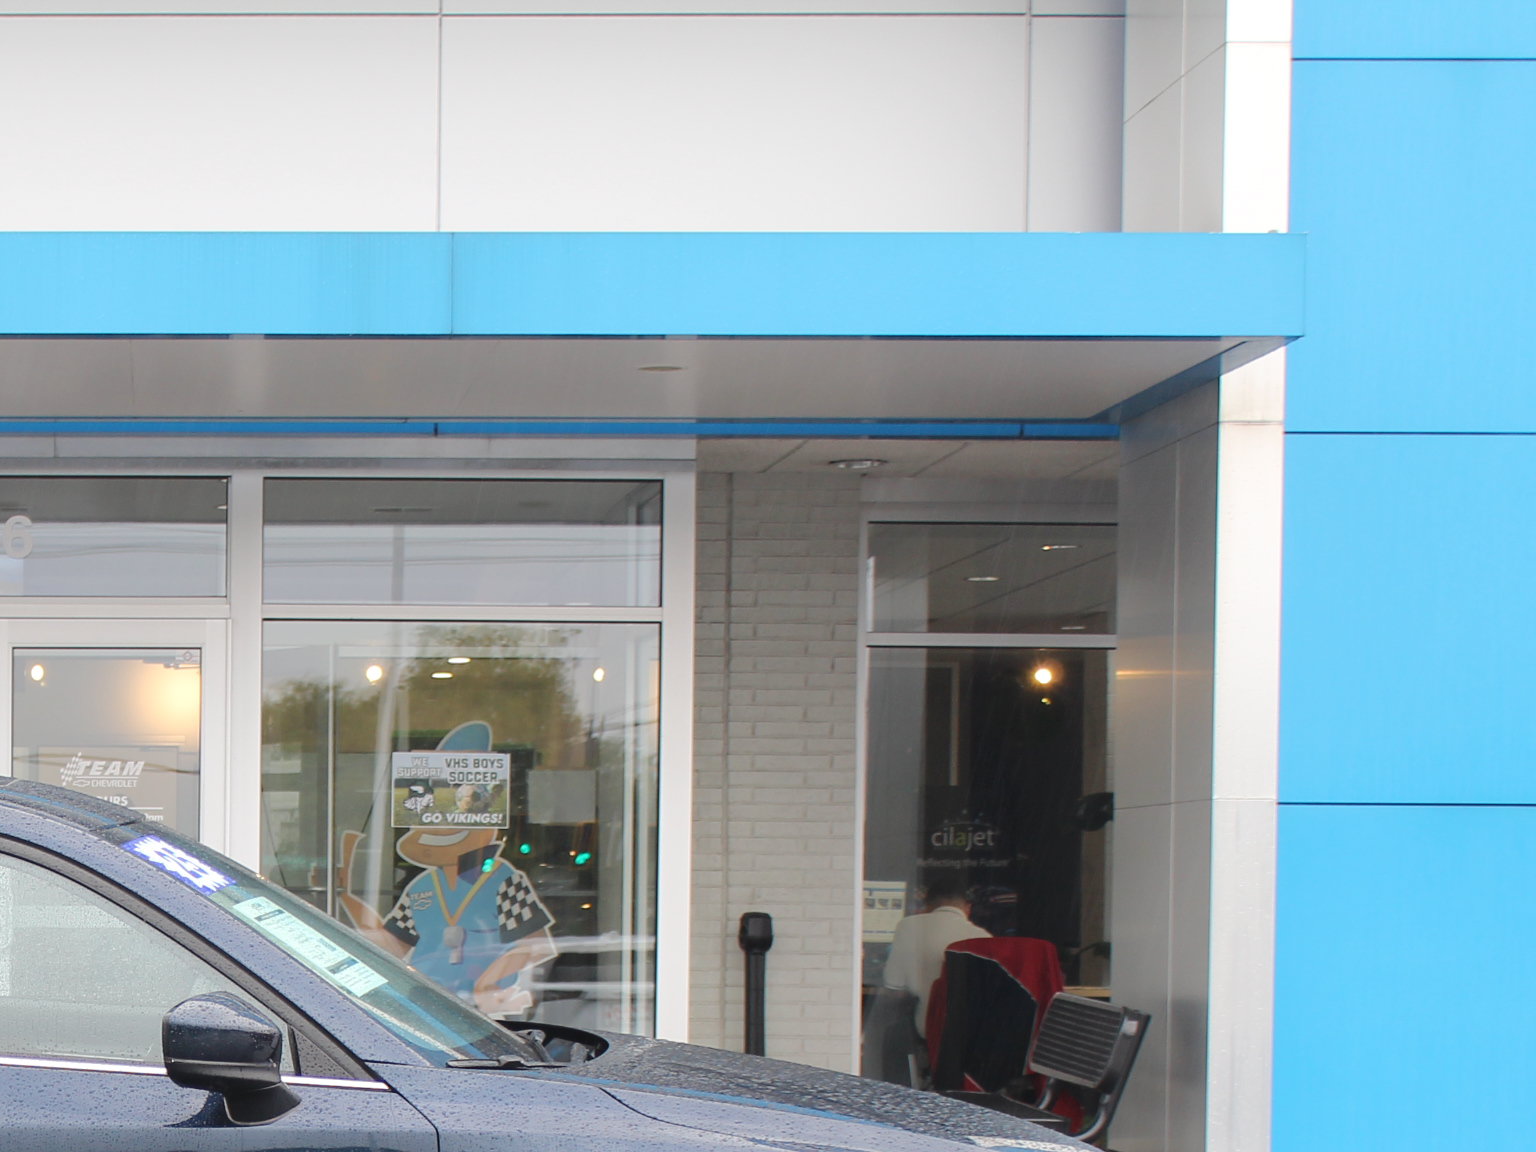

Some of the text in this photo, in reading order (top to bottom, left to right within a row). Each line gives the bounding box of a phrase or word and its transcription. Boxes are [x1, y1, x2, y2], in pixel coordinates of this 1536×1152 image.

[411, 757, 429, 767] WE
[445, 758, 504, 769] VHS BOYS
[76, 761, 144, 776] TEAM
[397, 767, 441, 778] SUPPORT
[448, 771, 499, 783] SOCCER
[91, 780, 138, 788] CHEVROLET
[421, 812, 504, 824] GO VIKINGS!
[930, 825, 996, 852] cilajet
